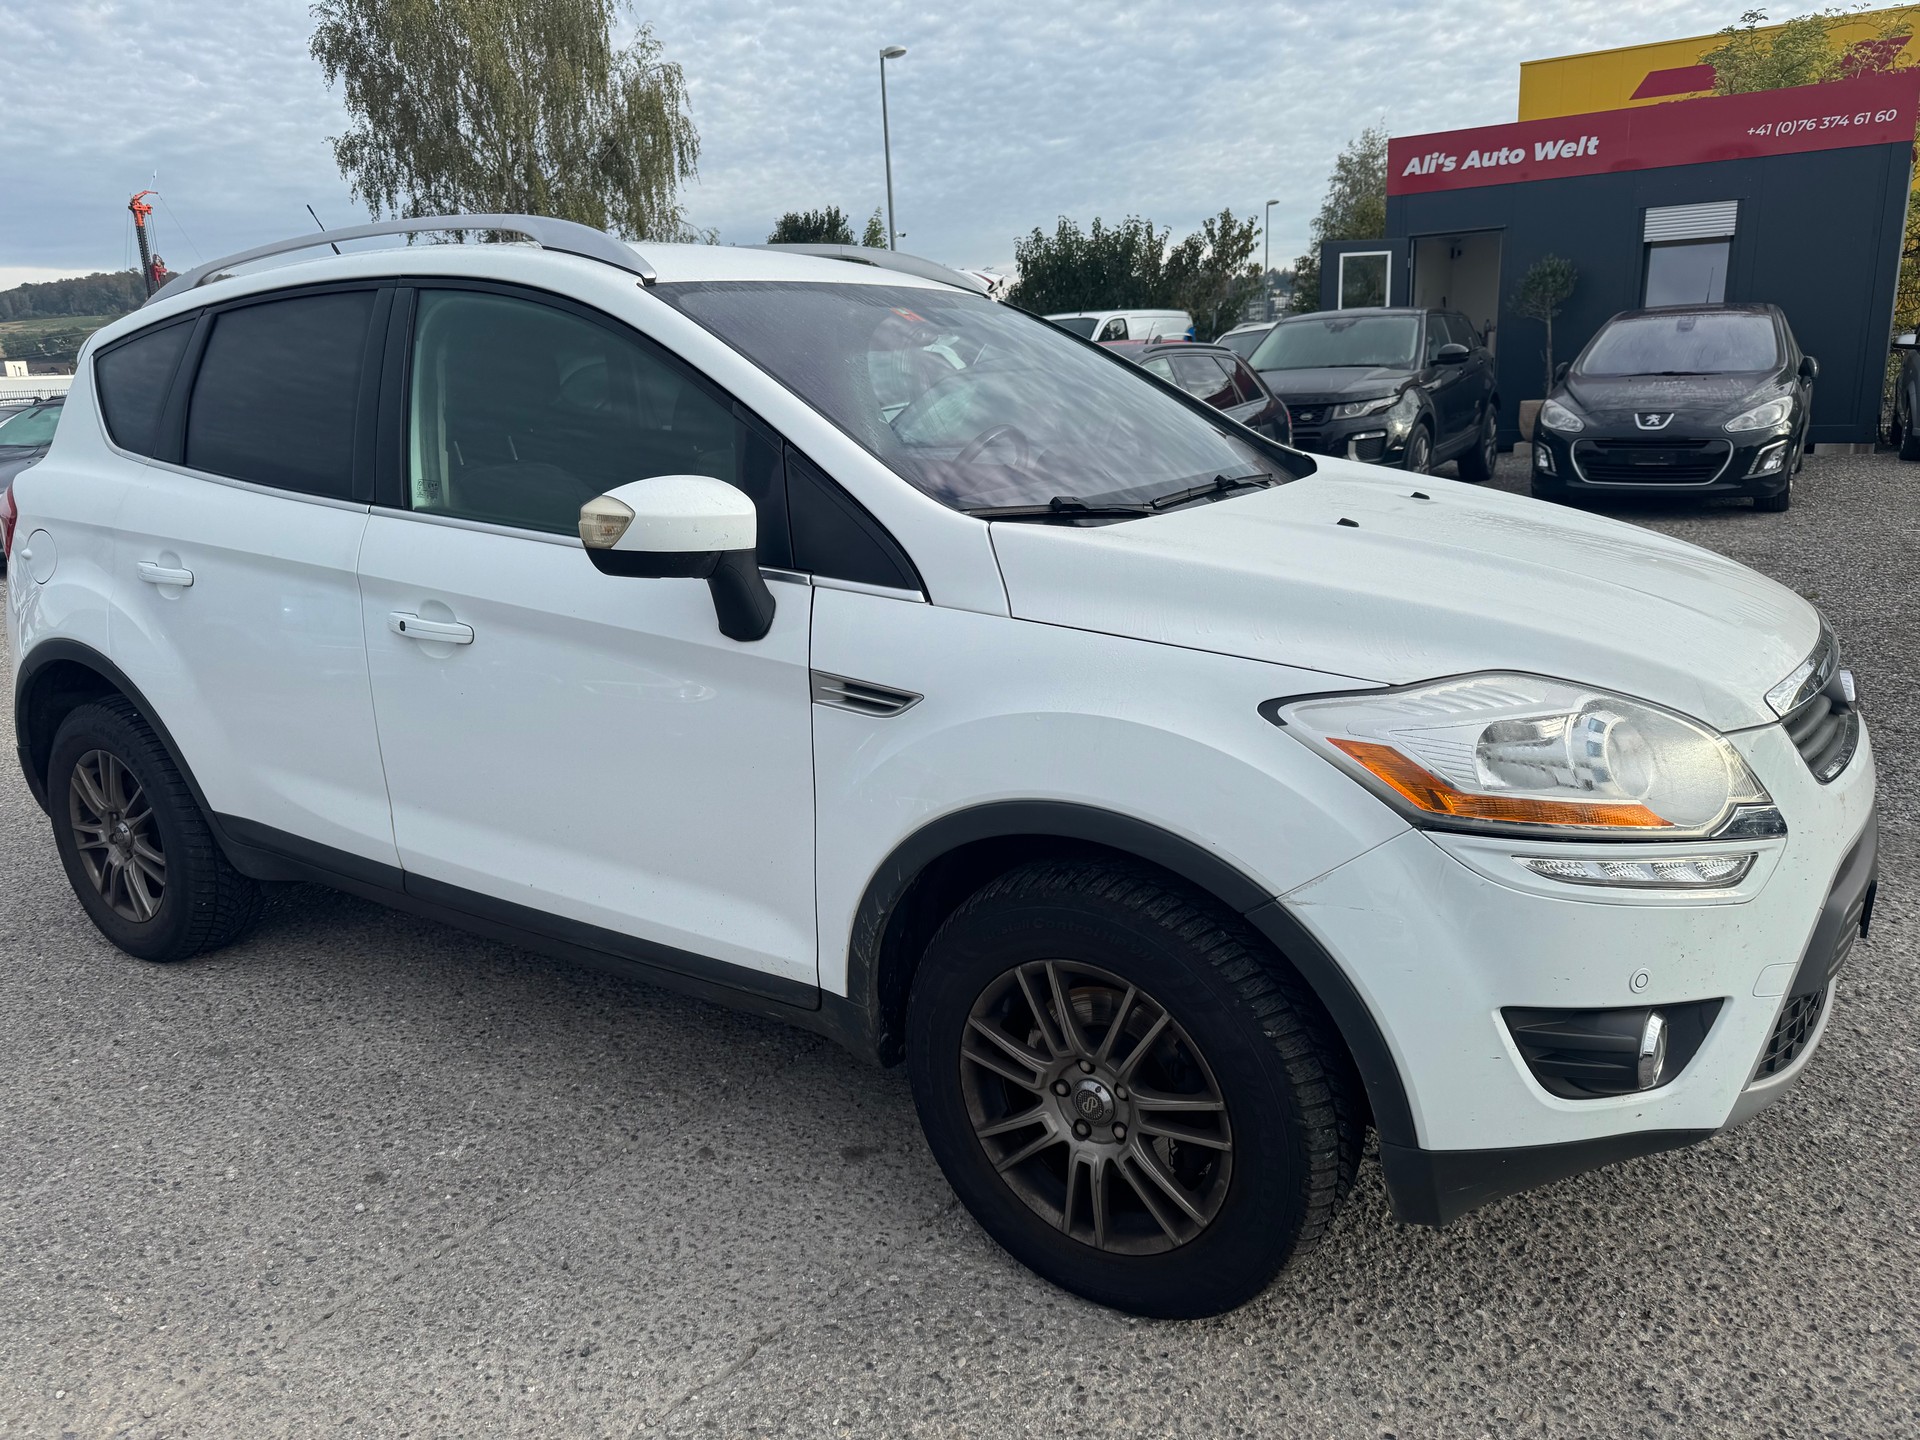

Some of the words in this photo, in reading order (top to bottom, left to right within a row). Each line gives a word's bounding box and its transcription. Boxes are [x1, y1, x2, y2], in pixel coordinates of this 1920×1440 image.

[1747, 123, 1772, 136] +41
[1775, 118, 1818, 137] (0)76
[1819, 114, 1850, 130] 374
[1853, 111, 1872, 125] 61
[1874, 108, 1898, 123] 60
[1460, 147, 1526, 170] Auto
[1534, 135, 1600, 161] Welt
